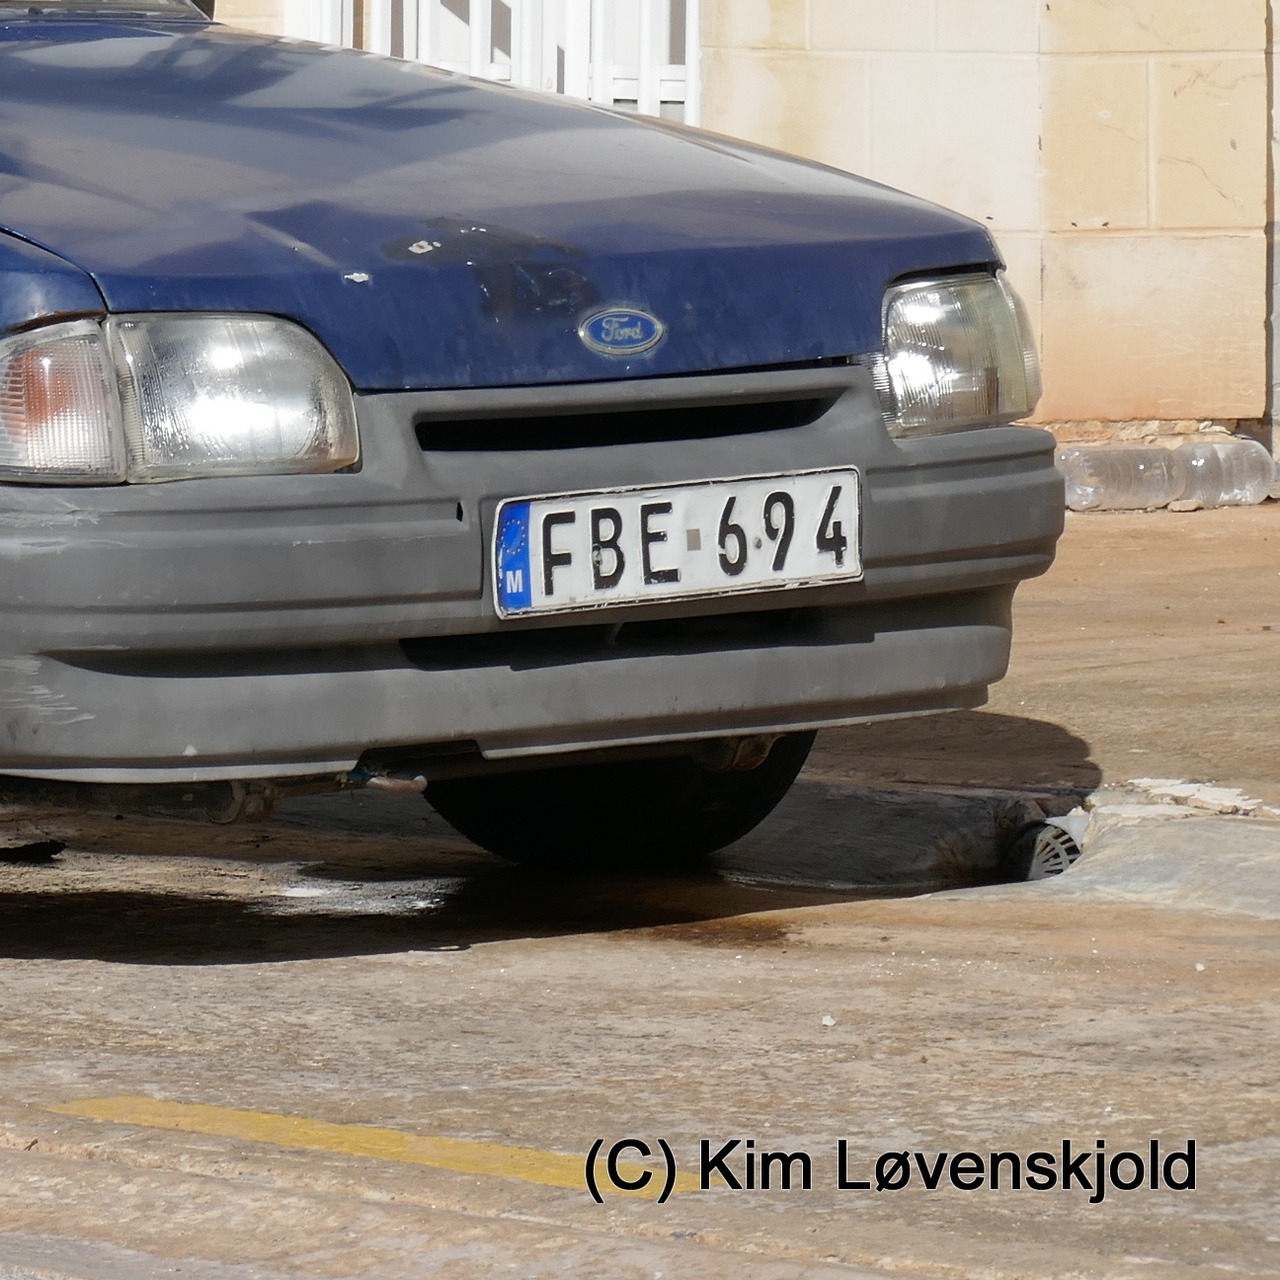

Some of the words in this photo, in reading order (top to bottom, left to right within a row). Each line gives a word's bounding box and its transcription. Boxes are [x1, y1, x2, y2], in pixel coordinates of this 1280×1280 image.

[601, 316, 644, 342] Ford
[541, 500, 682, 596] FBE
[716, 484, 848, 577] 694
[505, 569, 524, 594] M
